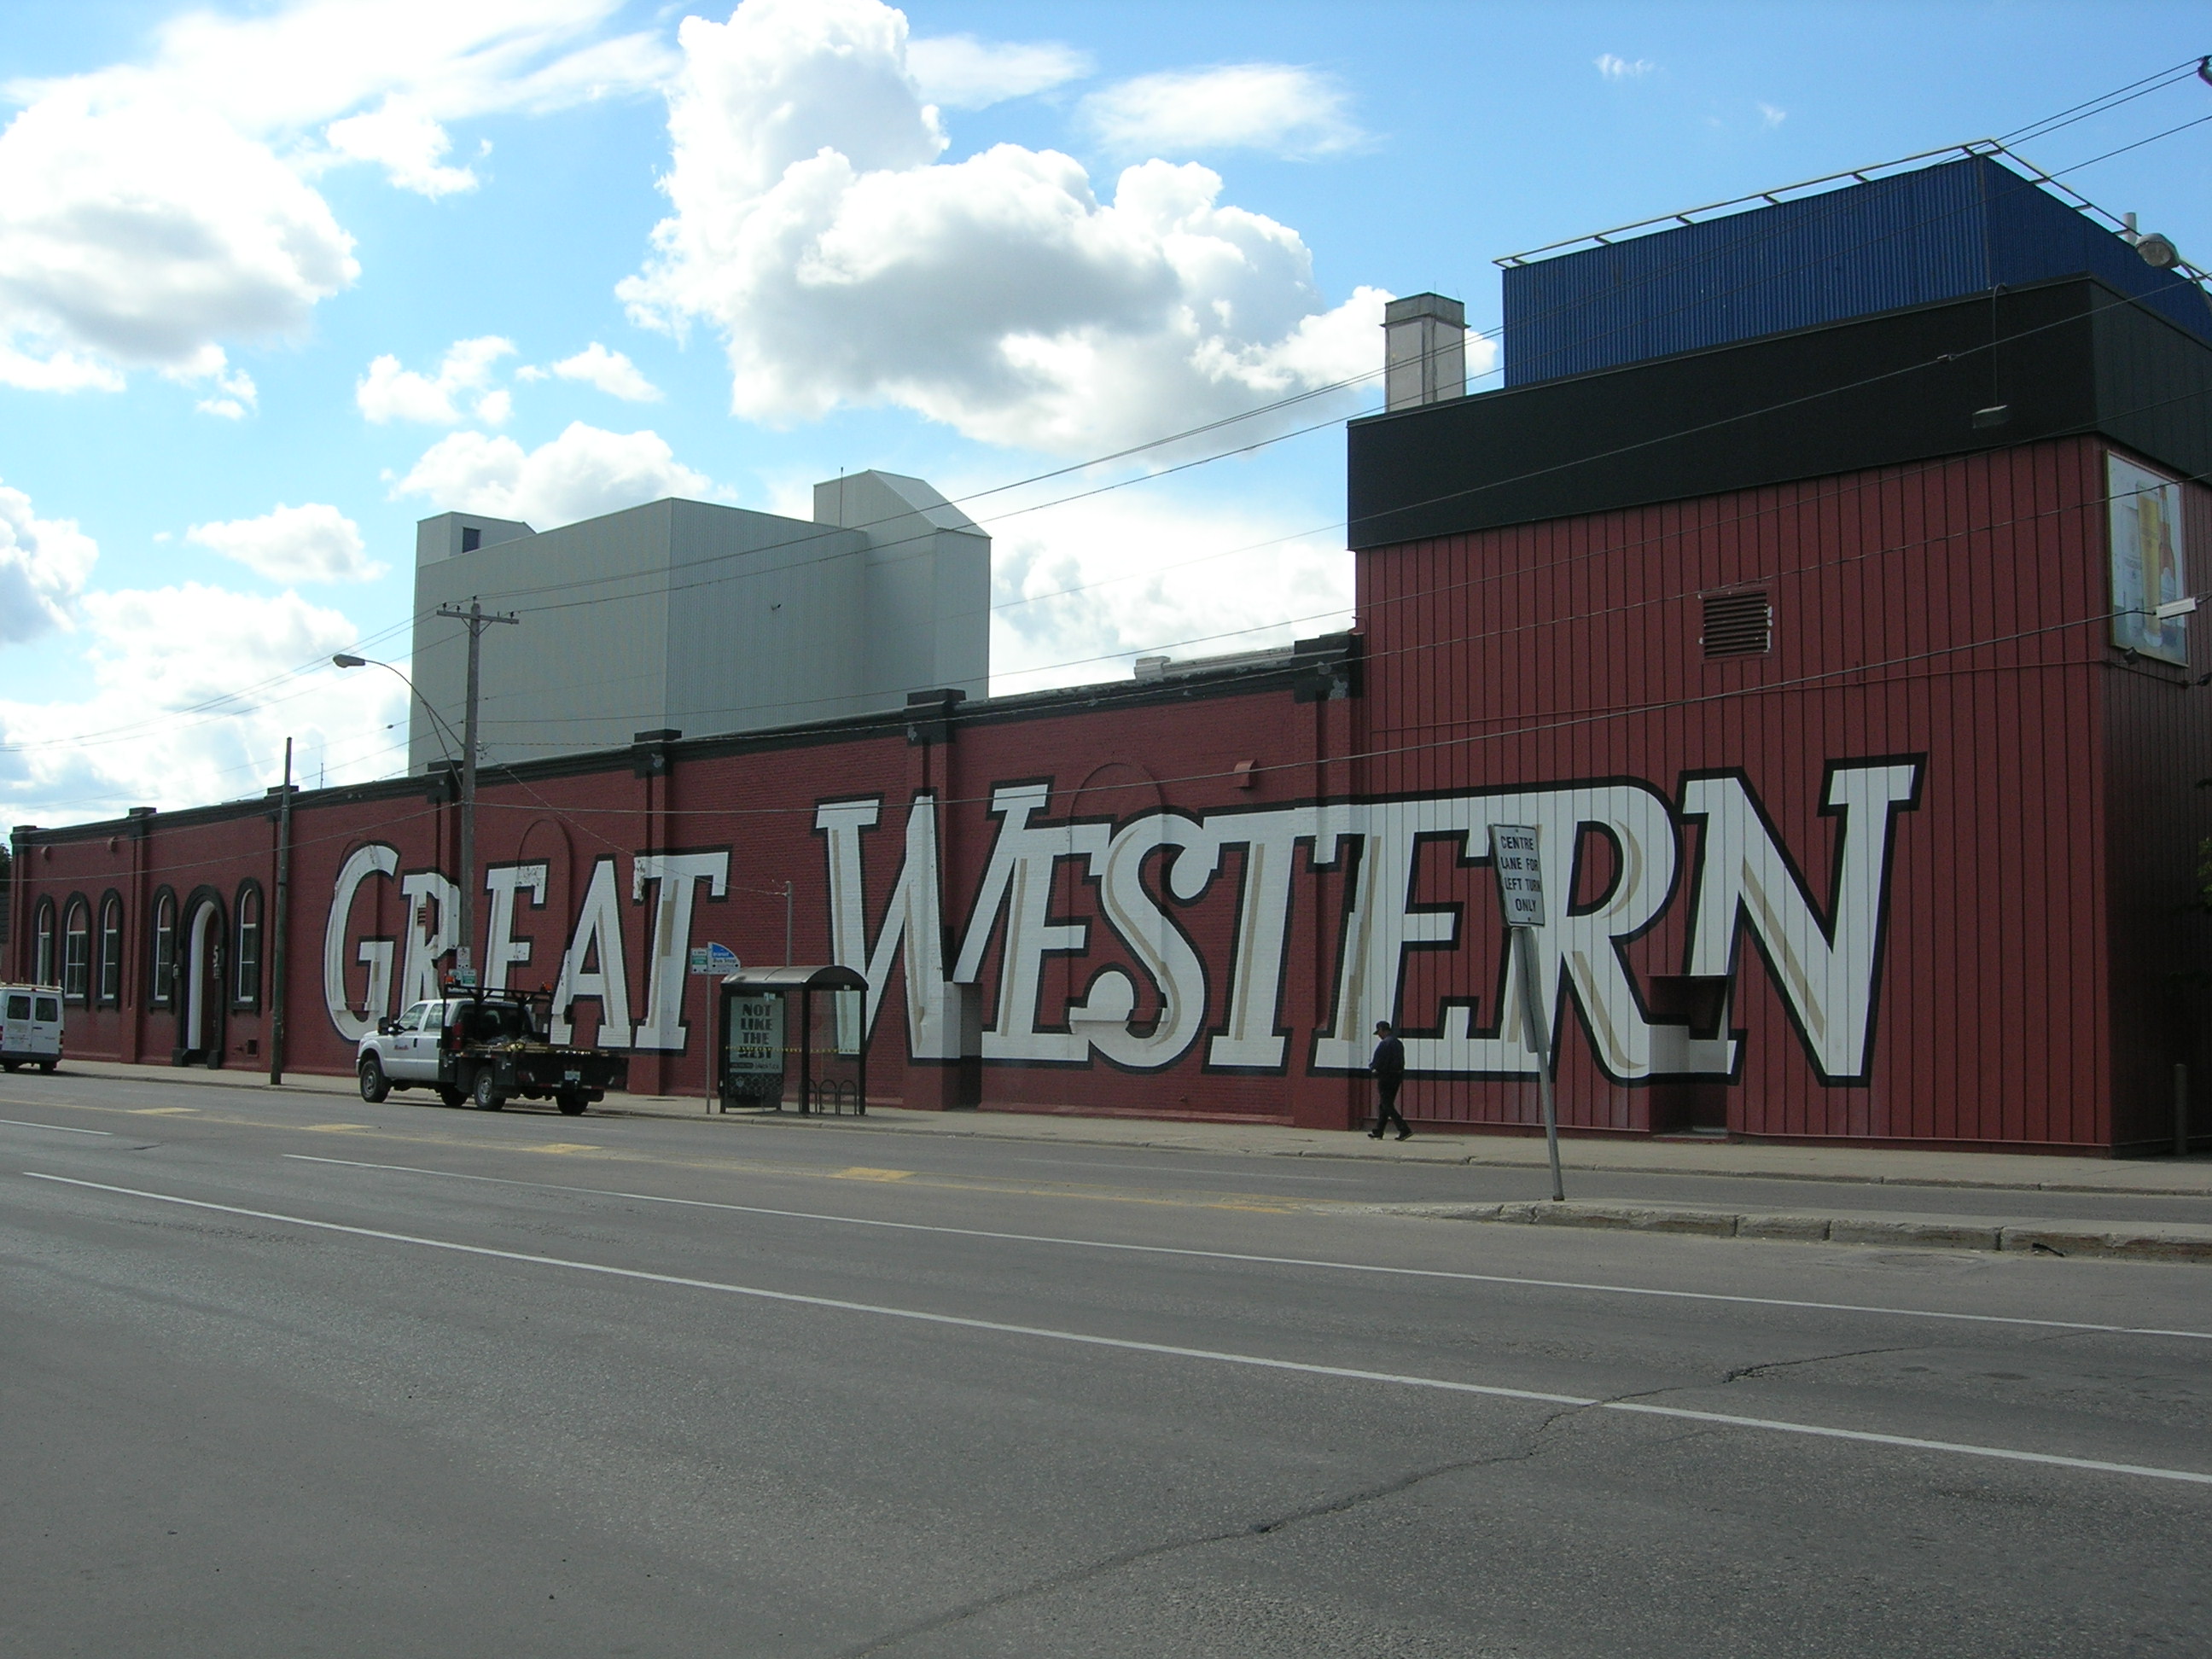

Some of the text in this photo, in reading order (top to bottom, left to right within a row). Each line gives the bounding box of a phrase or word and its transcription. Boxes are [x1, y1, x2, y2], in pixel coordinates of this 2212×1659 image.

[1500, 835, 1534, 850] CENTRE
[1500, 857, 1539, 872] LANE FOR
[1505, 878, 1541, 893] LEFT TURN
[1515, 899, 1537, 912] ONLY
[324, 761, 1921, 1079] GREAT WESTERN
[742, 1004, 771, 1016] NOT
[741, 1017, 772, 1030] LIKE
[742, 1032, 769, 1045] THE
